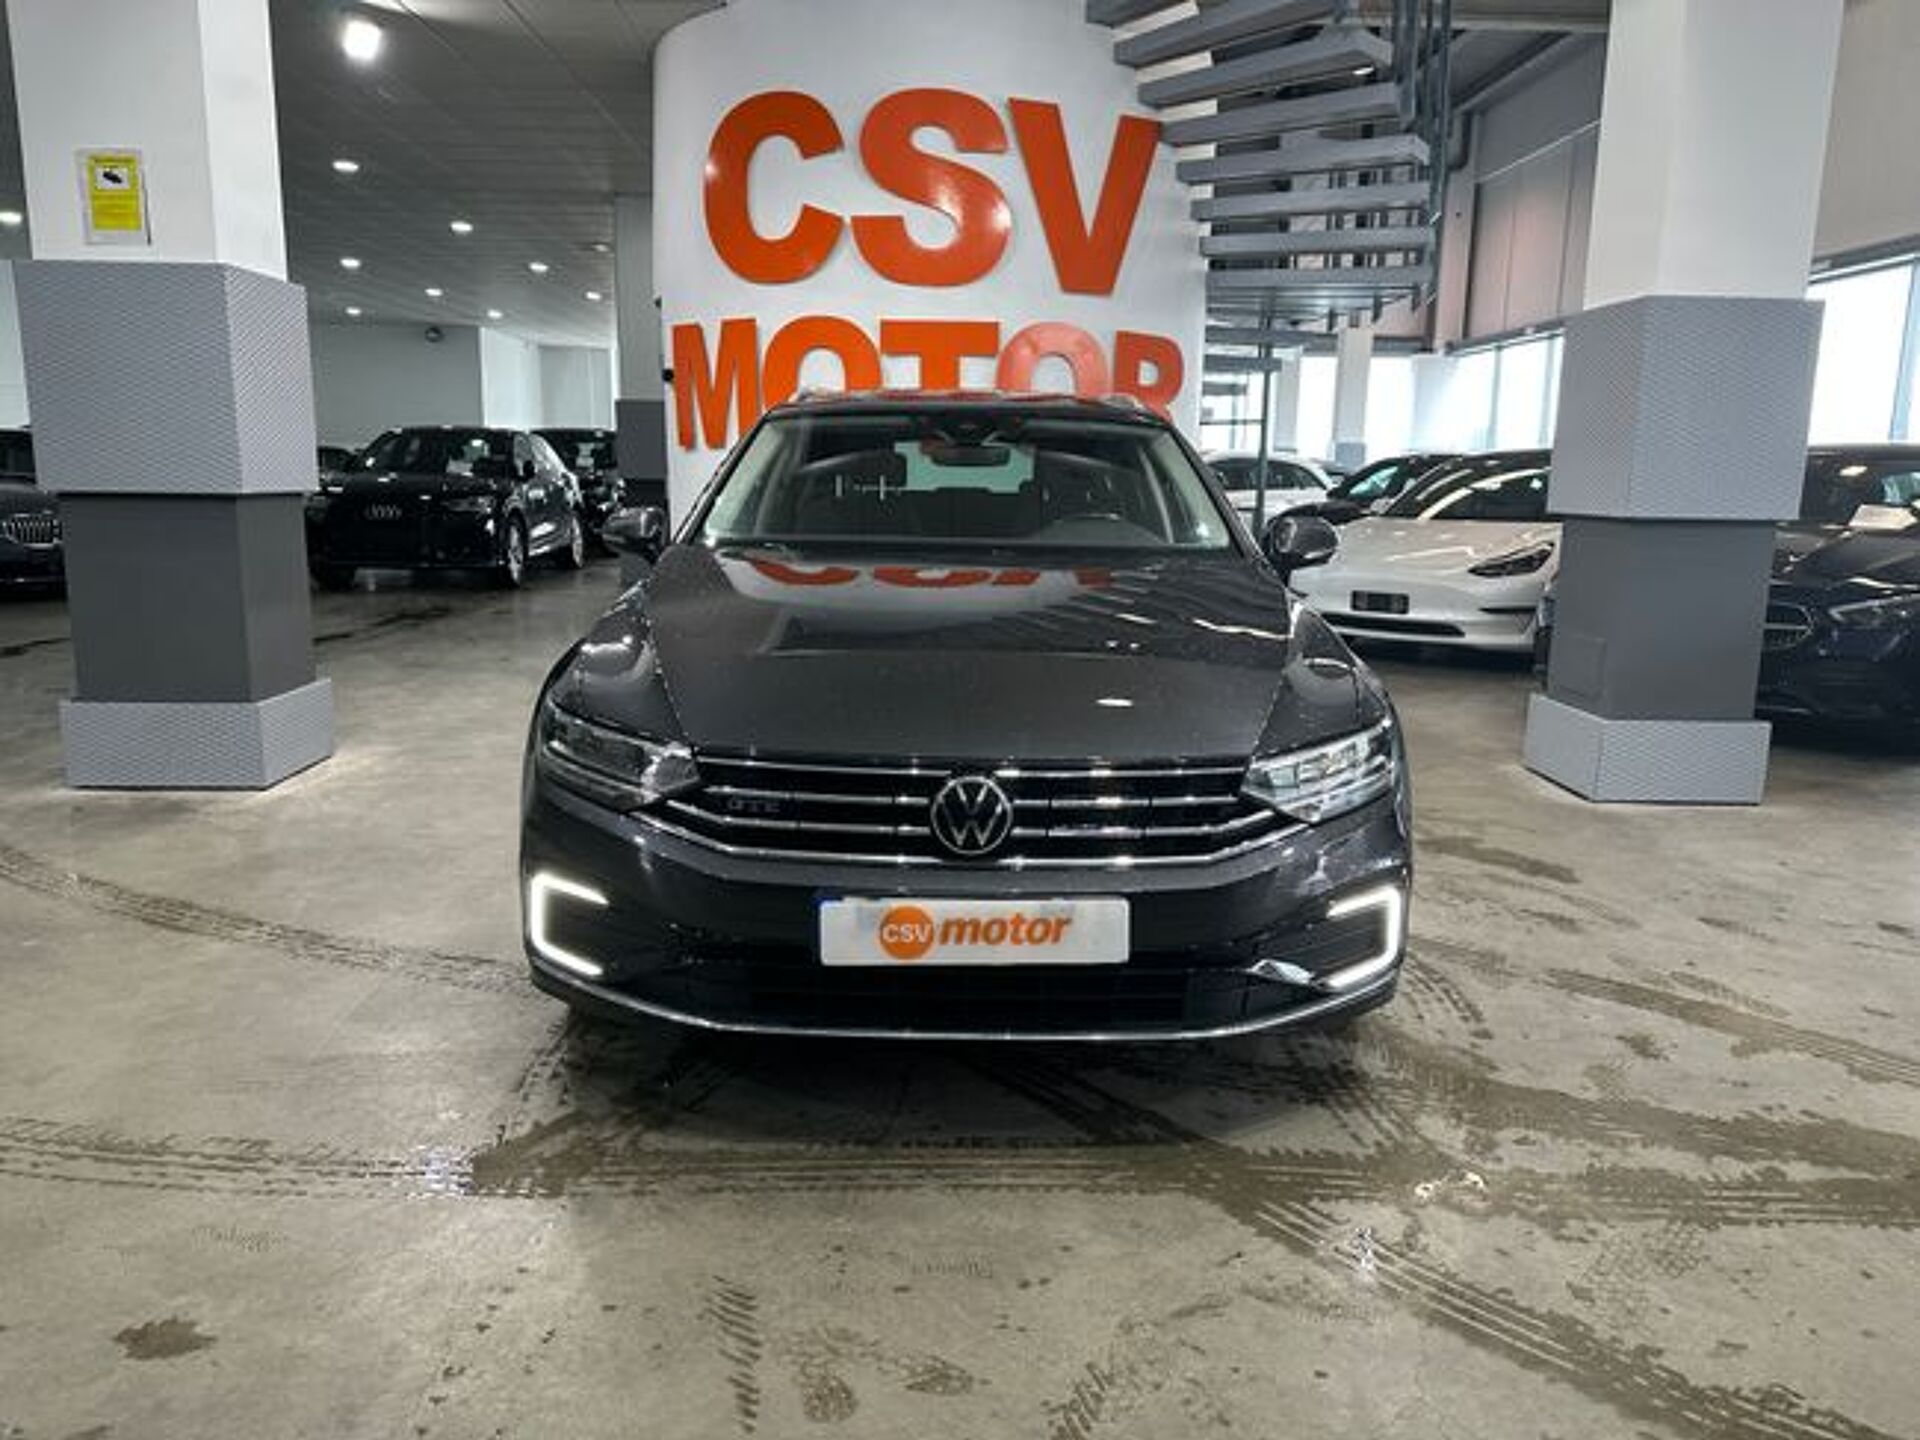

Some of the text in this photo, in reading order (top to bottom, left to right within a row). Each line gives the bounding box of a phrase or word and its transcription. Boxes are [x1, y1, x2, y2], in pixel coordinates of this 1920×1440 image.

[703, 88, 1162, 297] CSV
[672, 315, 1184, 451] MOTOR
[882, 912, 1073, 946] CSV motor
